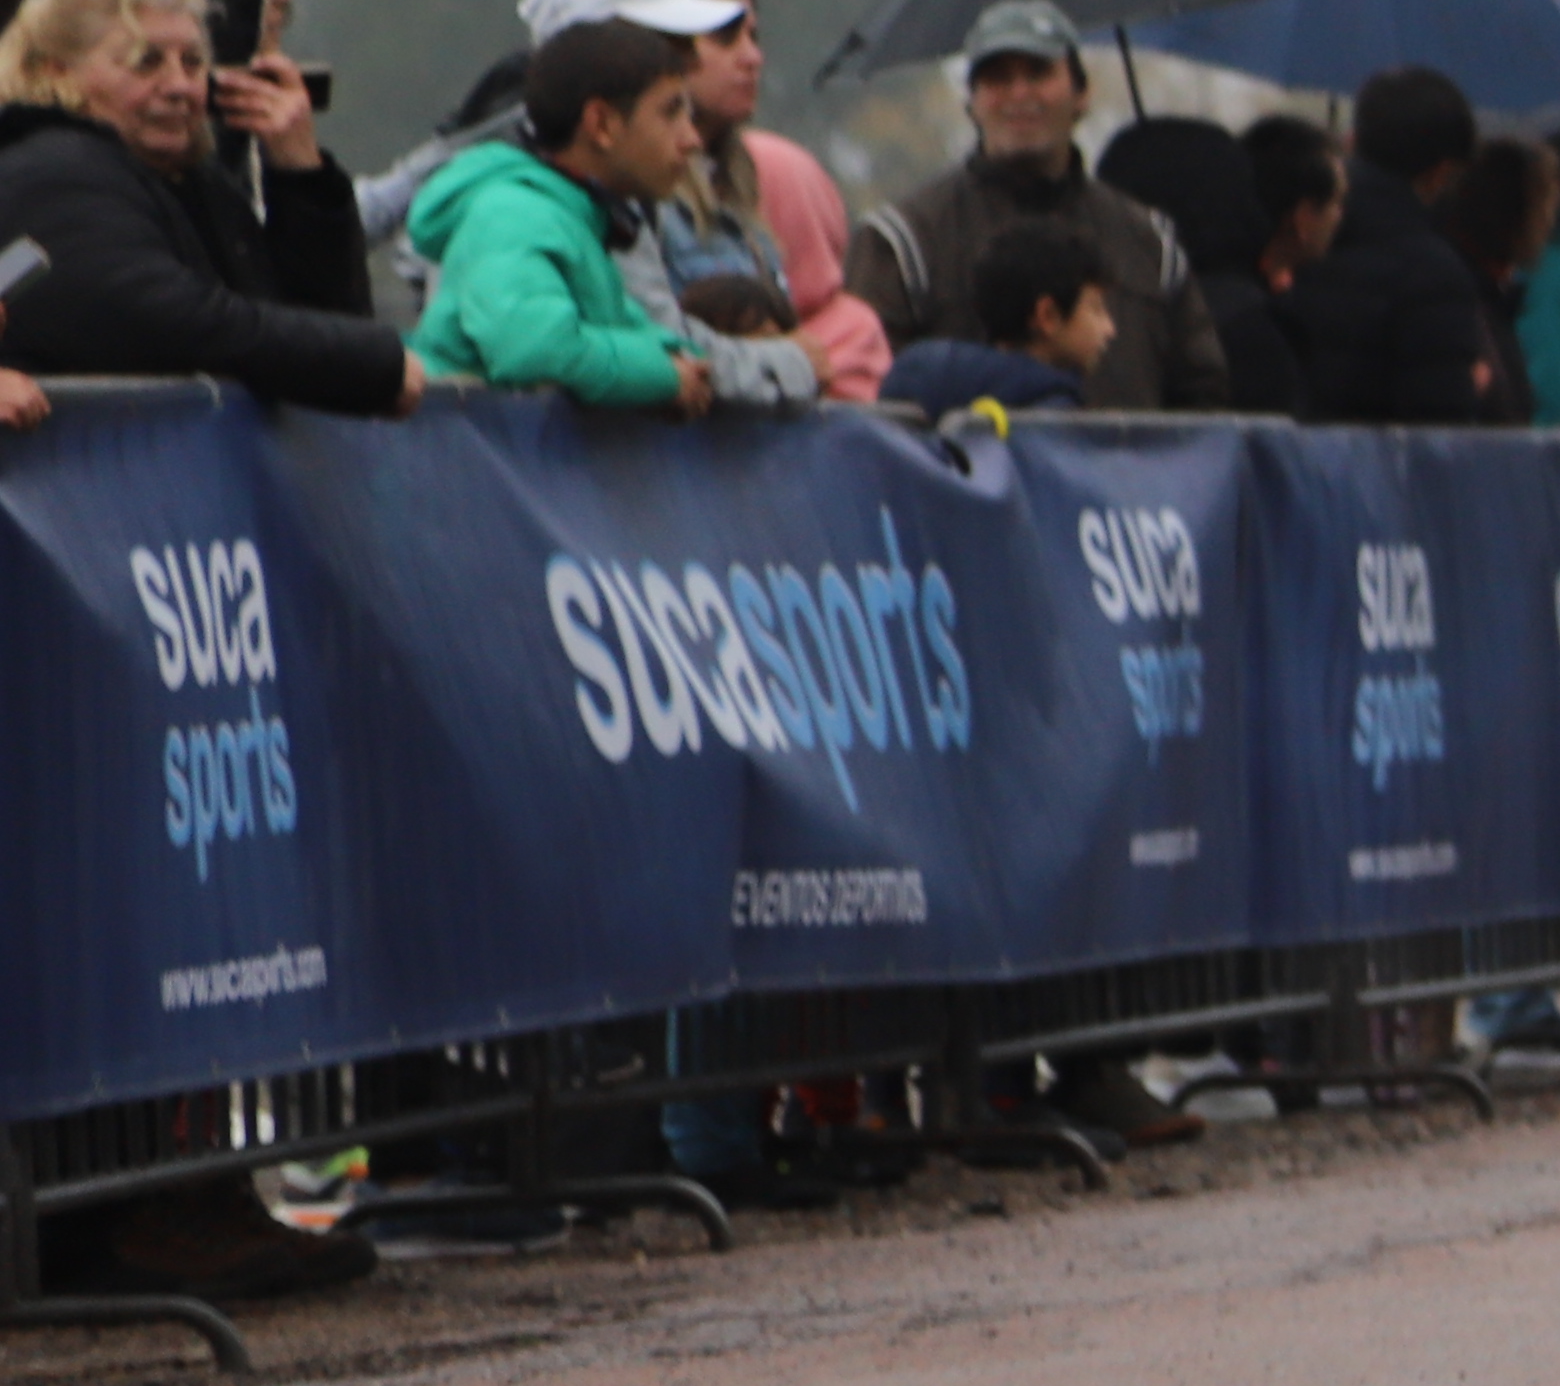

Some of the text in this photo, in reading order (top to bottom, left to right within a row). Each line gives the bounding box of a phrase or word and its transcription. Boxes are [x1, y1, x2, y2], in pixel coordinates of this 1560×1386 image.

[130, 538, 276, 691] suca
[1077, 506, 1201, 625] suca
[1356, 543, 1436, 652] suca
[546, 504, 971, 813] sucasports
[163, 685, 297, 883] sports
